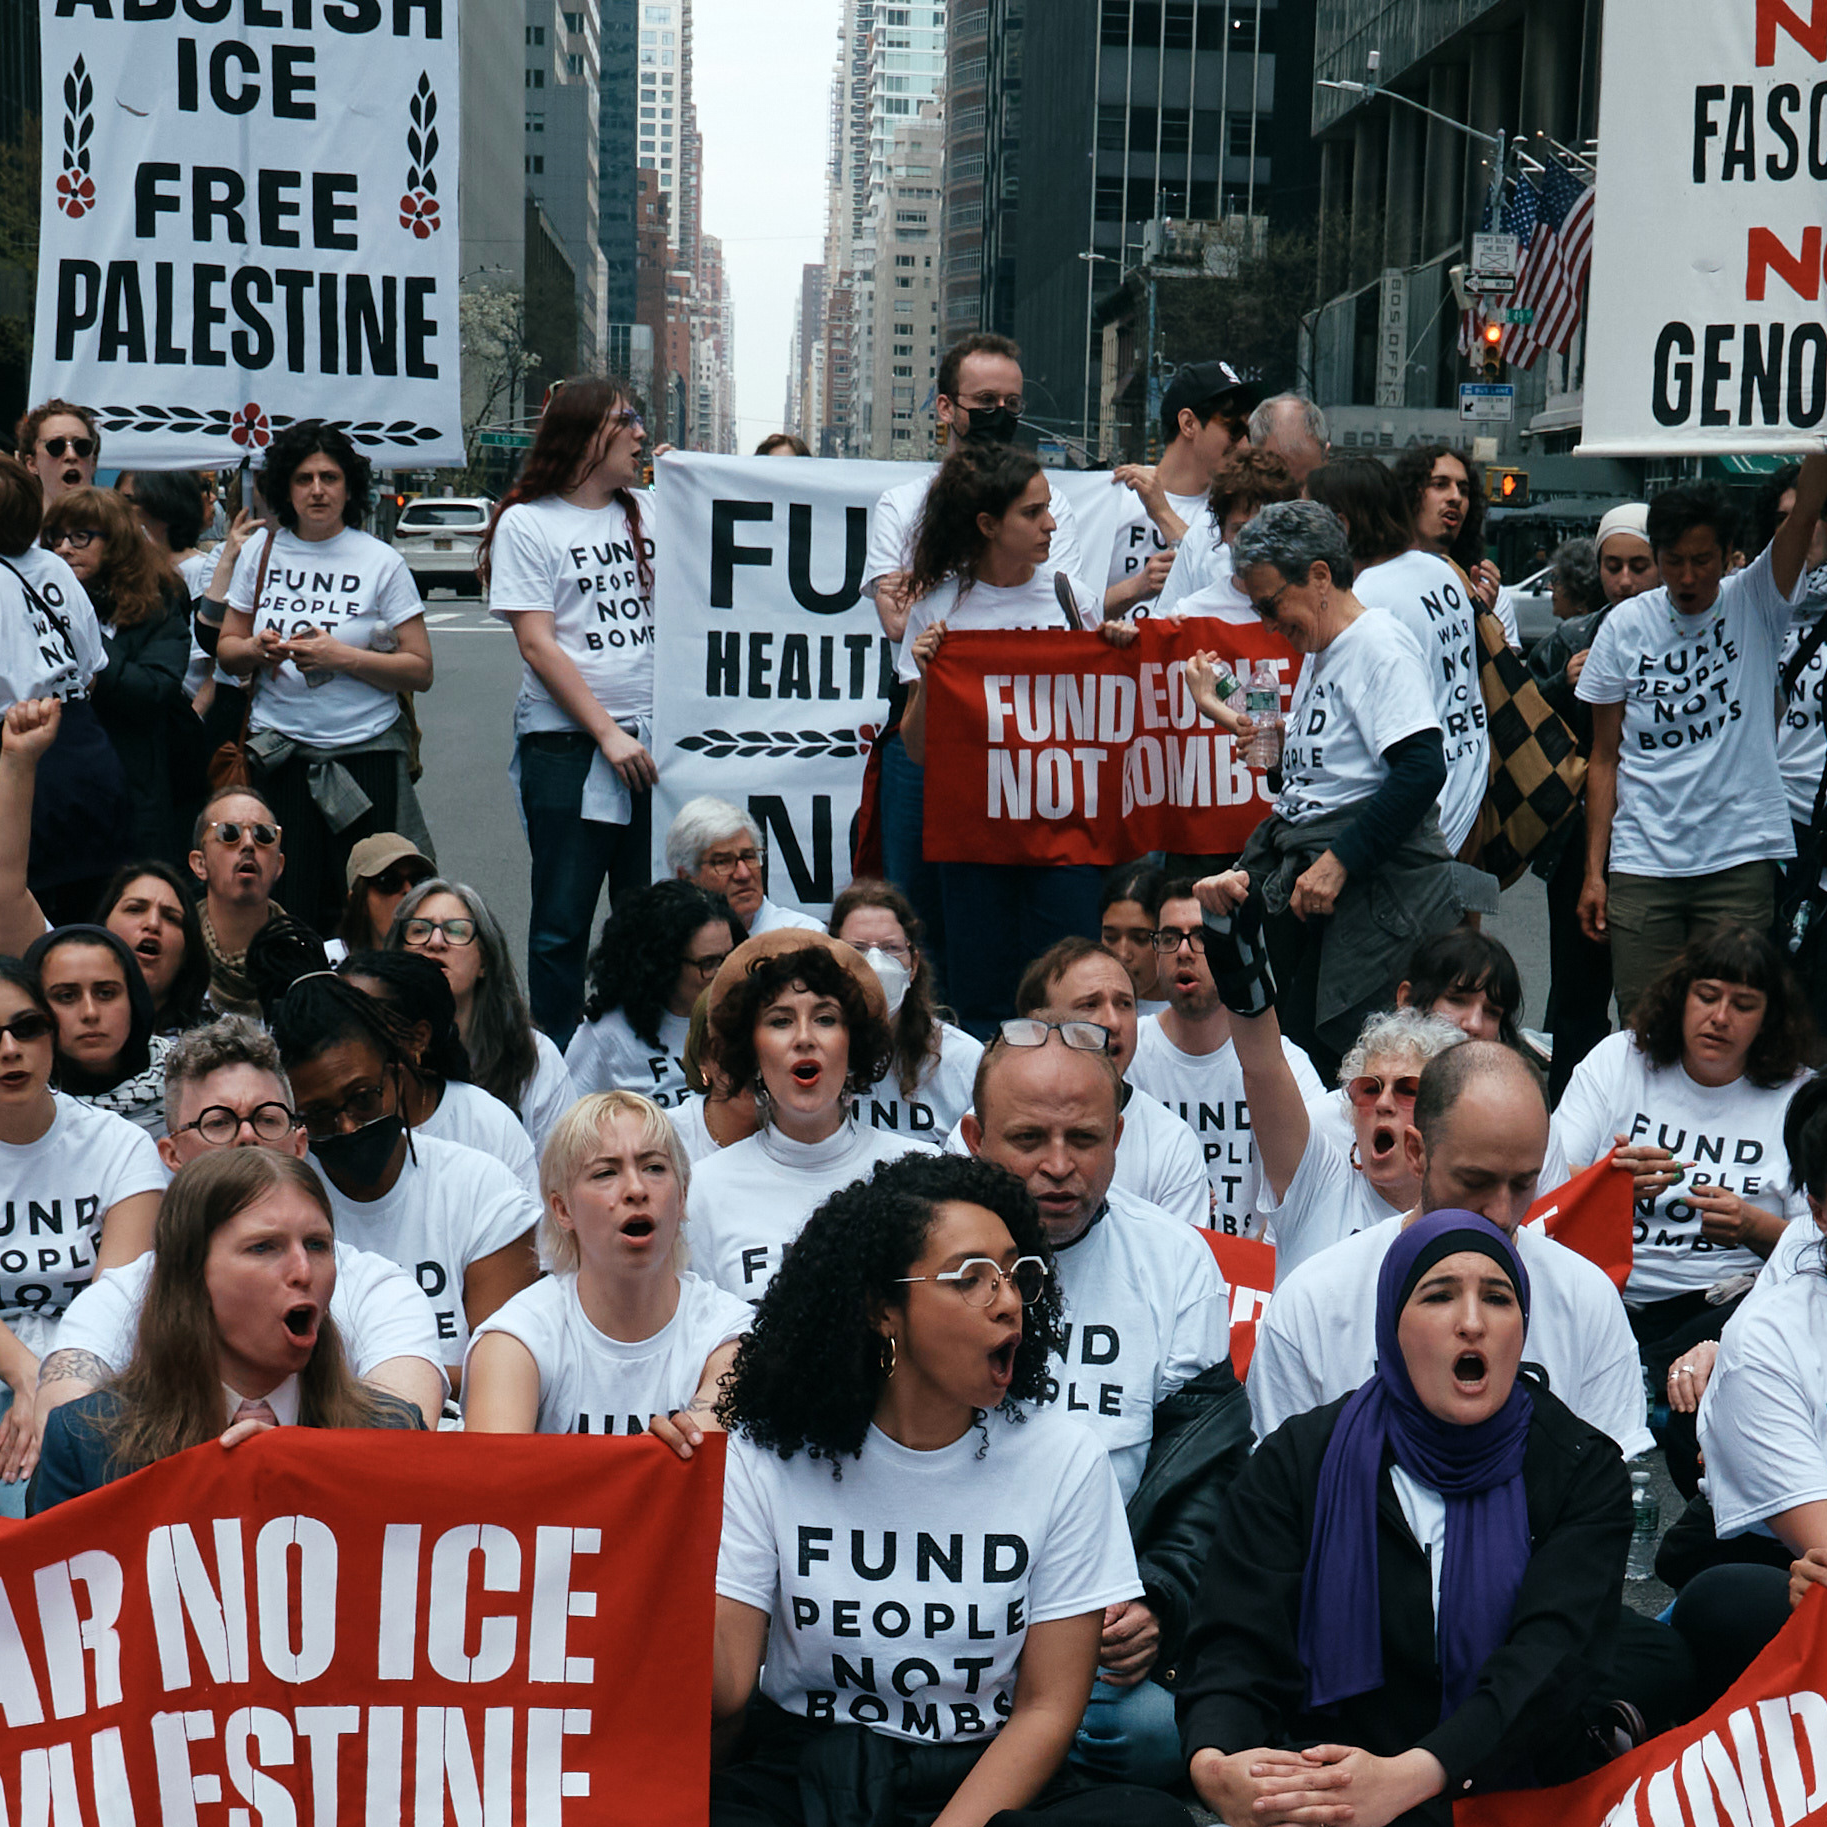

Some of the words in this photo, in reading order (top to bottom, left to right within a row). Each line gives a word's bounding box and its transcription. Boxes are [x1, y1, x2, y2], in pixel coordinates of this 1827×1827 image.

[177, 37, 317, 121] ICE
[134, 162, 358, 251] FREE
[55, 258, 440, 381] PALESTINE
[710, 499, 867, 616] FU
[1129, 525, 1169, 550] FU
[258, 596, 360, 617] PEOPLE
[266, 568, 361, 594] FUND
[1420, 583, 1461, 622] NO
[1437, 618, 1470, 646] WAR
[706, 629, 891, 700] HEALT
[983, 672, 1136, 744] FUND
[1654, 678, 1730, 724] NOT
[985, 745, 1108, 820] NOT
[1629, 1111, 1764, 1166] FUND
[796, 1524, 1030, 1584] FUND
[145, 1514, 337, 1693] NO
[376, 1521, 603, 1685] ICE
[791, 1594, 1026, 1640] PEOPLE
[831, 1652, 995, 1697] NOT
[805, 1689, 1014, 1740] BOMBS
